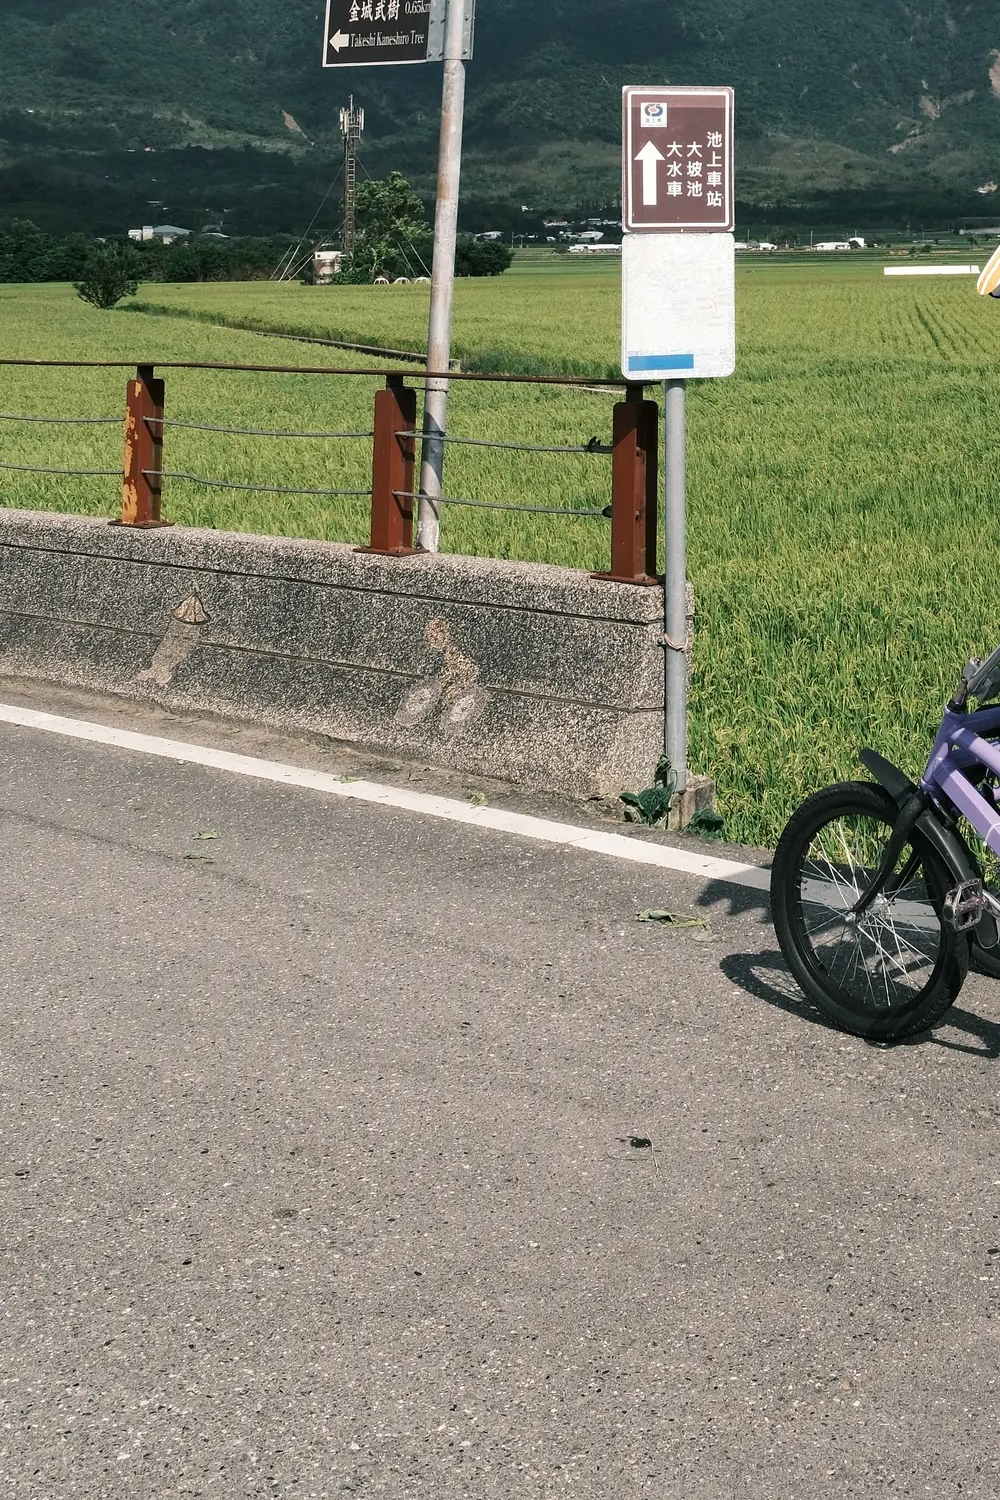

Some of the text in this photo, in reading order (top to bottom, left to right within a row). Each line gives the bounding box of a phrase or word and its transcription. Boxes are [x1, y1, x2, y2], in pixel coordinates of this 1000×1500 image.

[350, 30, 425, 48] Takeshi Kaneshiro Tree
[666, 141, 683, 197] 大水車
[686, 141, 703, 198] 大坡池
[706, 131, 723, 208] 池上車站
